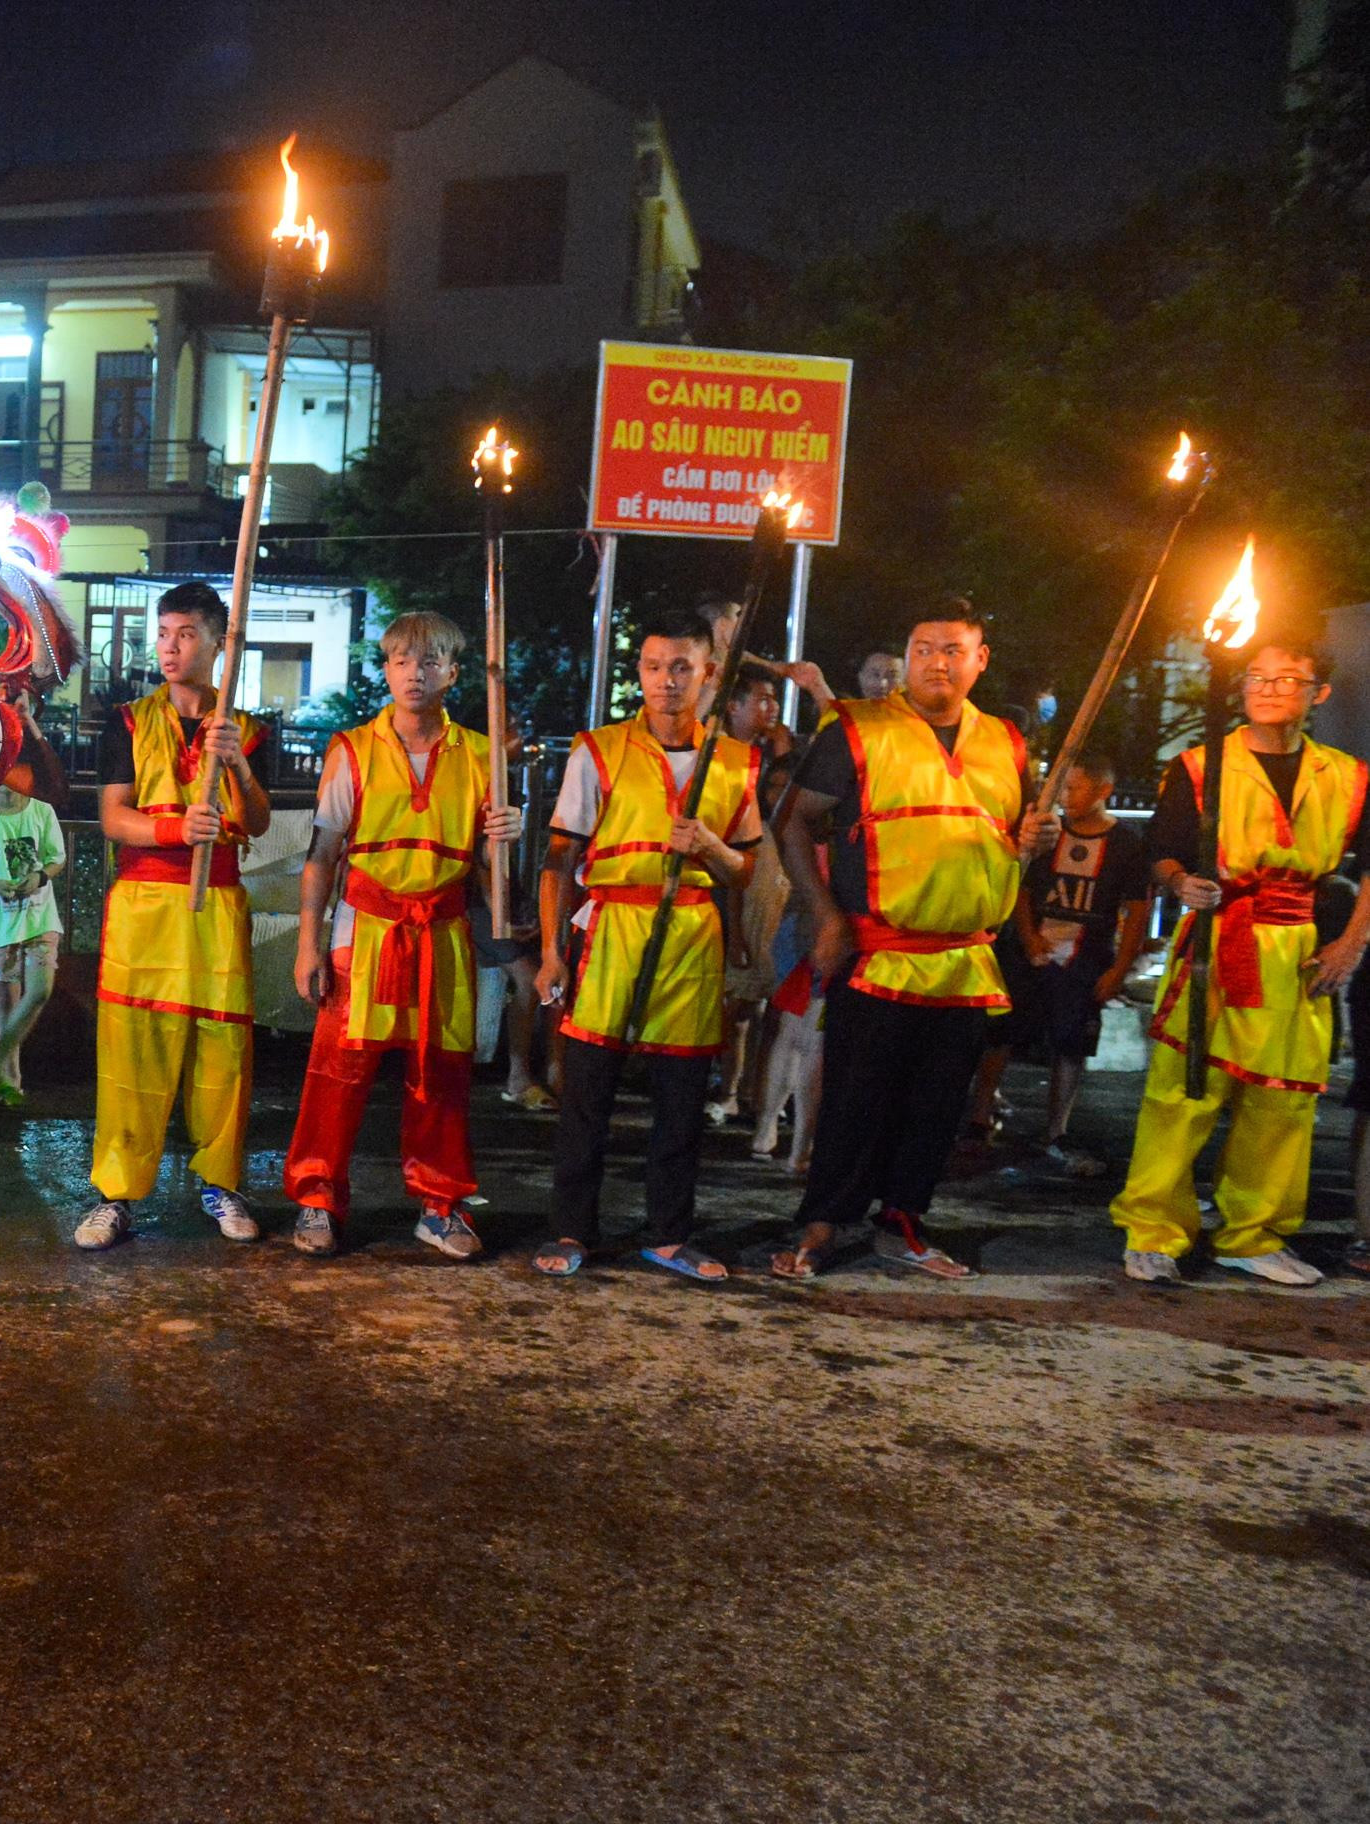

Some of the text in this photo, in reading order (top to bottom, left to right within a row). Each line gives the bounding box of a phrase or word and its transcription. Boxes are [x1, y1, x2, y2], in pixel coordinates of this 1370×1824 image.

[739, 382, 802, 415] BÁO
[611, 418, 645, 451] AO
[649, 415, 699, 454] SÂU
[703, 424, 767, 459] NGUY
[662, 461, 707, 489] CẤM
[710, 469, 742, 492] BƠI
[646, 495, 711, 523] PHÒNG
